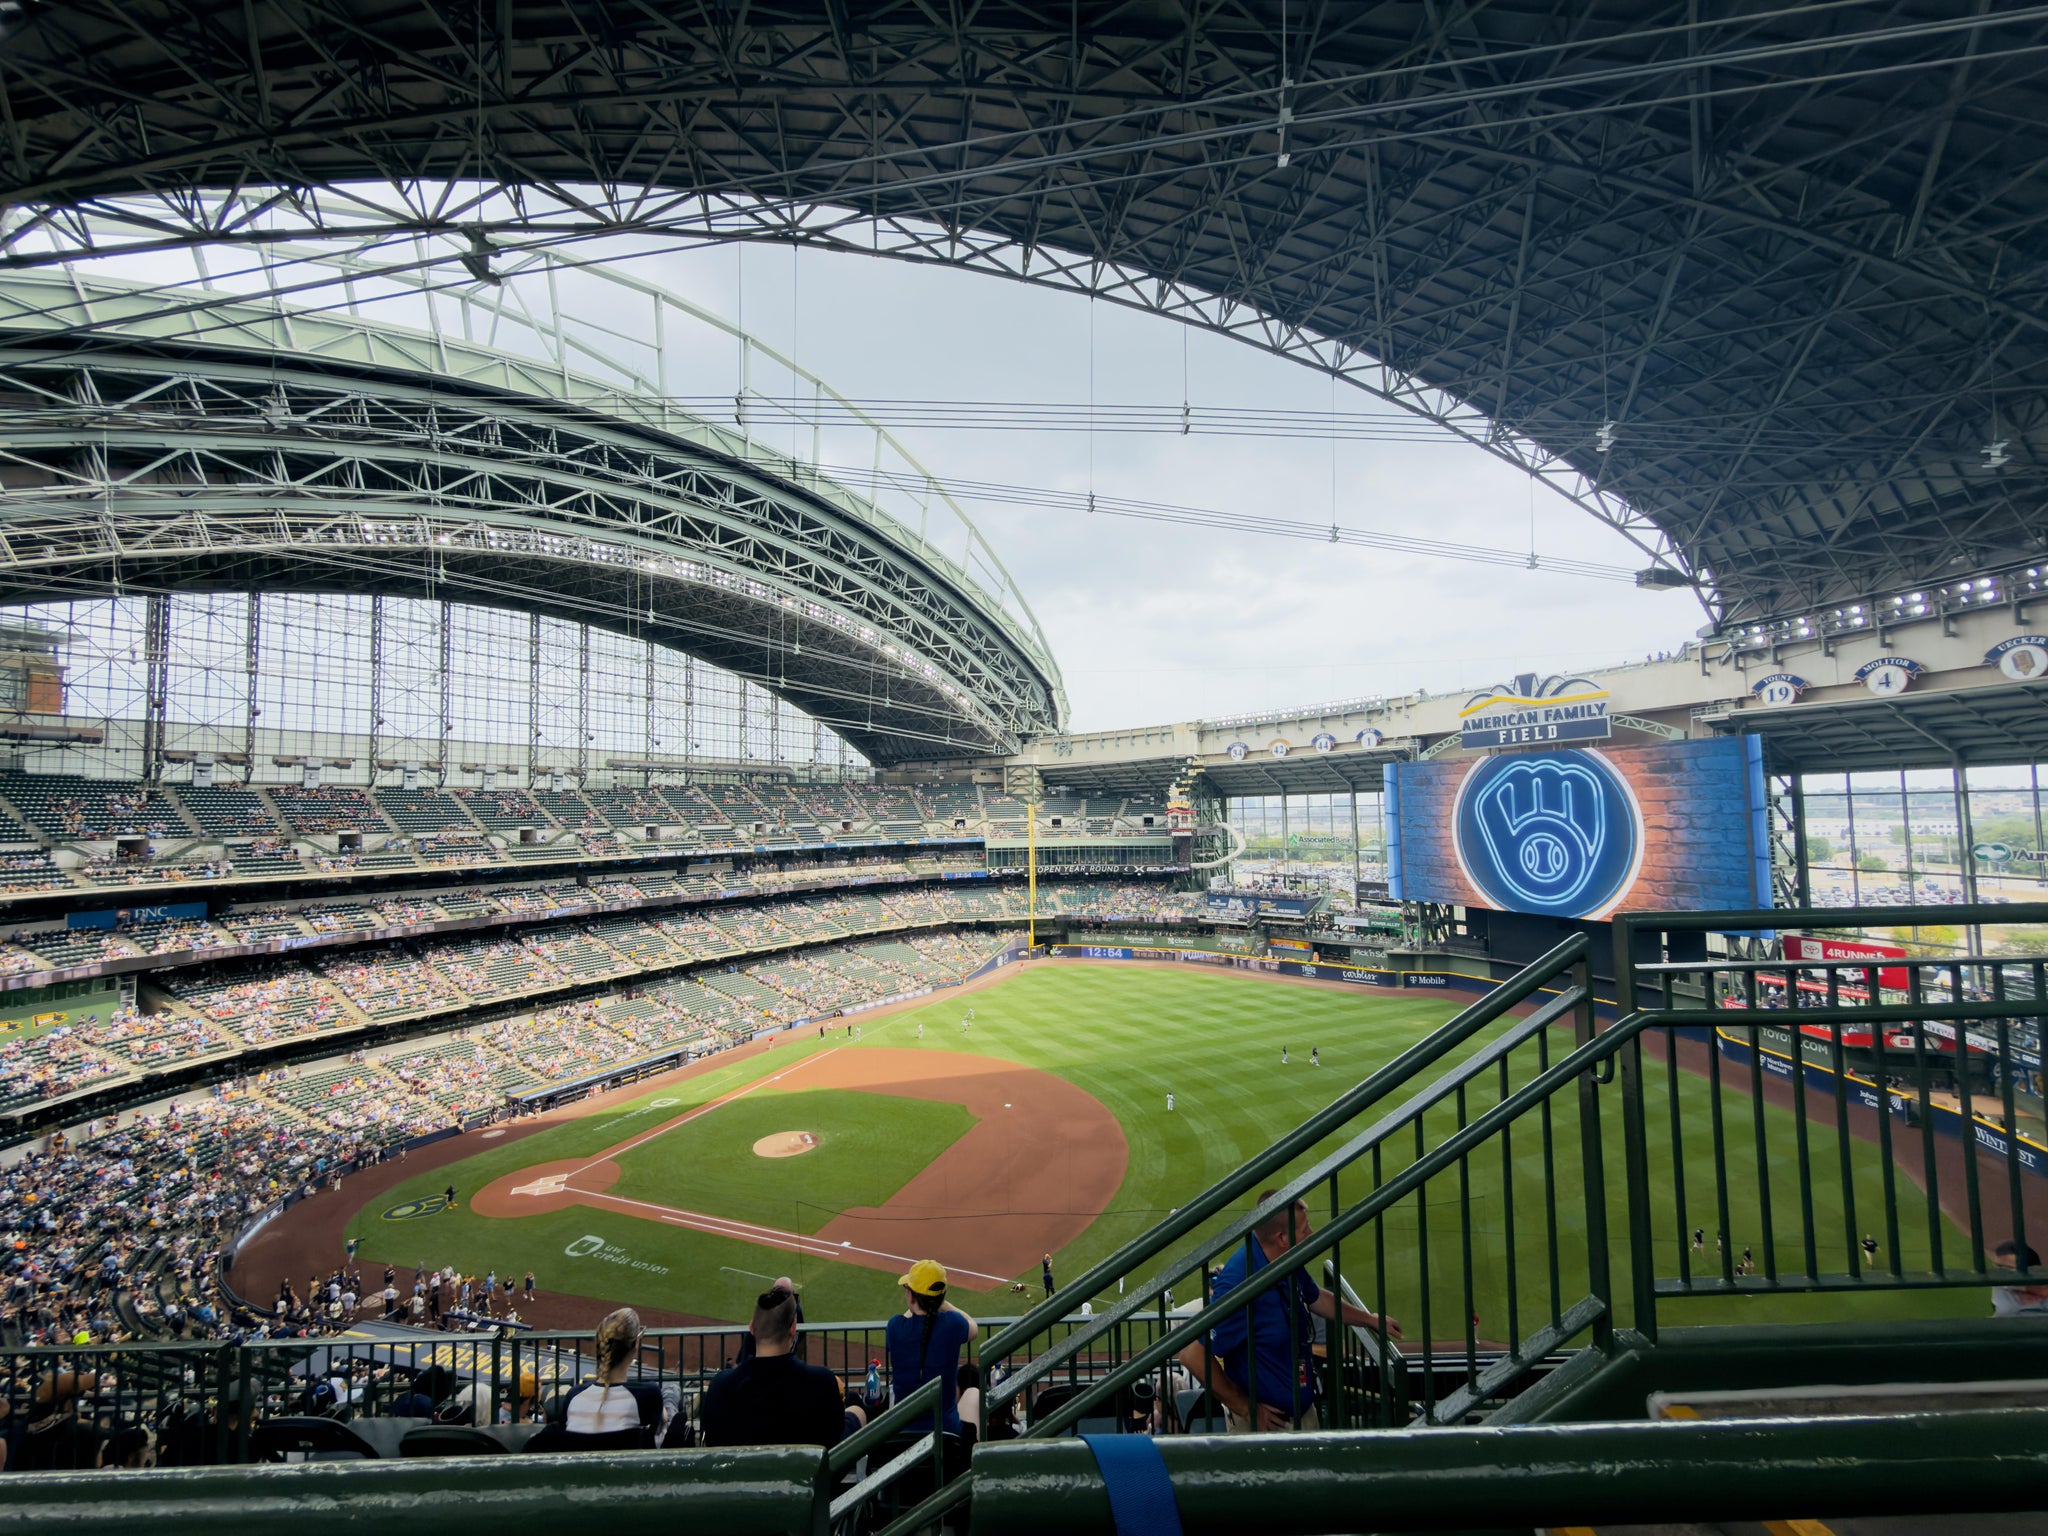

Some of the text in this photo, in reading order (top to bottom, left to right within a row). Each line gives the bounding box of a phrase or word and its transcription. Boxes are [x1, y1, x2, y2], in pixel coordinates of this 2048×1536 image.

[1997, 637, 2046, 651] UECKER
[1863, 658, 1910, 673] MOLITOR
[1763, 675, 1793, 684] YOUNT
[1878, 672, 1891, 688] 4
[1767, 686, 1789, 702] 19
[1462, 702, 1607, 731] AMERICAN FAMILY
[1498, 725, 1557, 743] FIELD
[1273, 745, 1285, 754] 42
[1317, 741, 1329, 750] 44
[1232, 748, 1242, 758] 34
[134, 906, 169, 919] PNC
[1767, 1064, 1788, 1075] Mutual
[1860, 1090, 1879, 1102] Johns
[1974, 1126, 2036, 1163] WINTST
[593, 1251, 670, 1275] credit union
